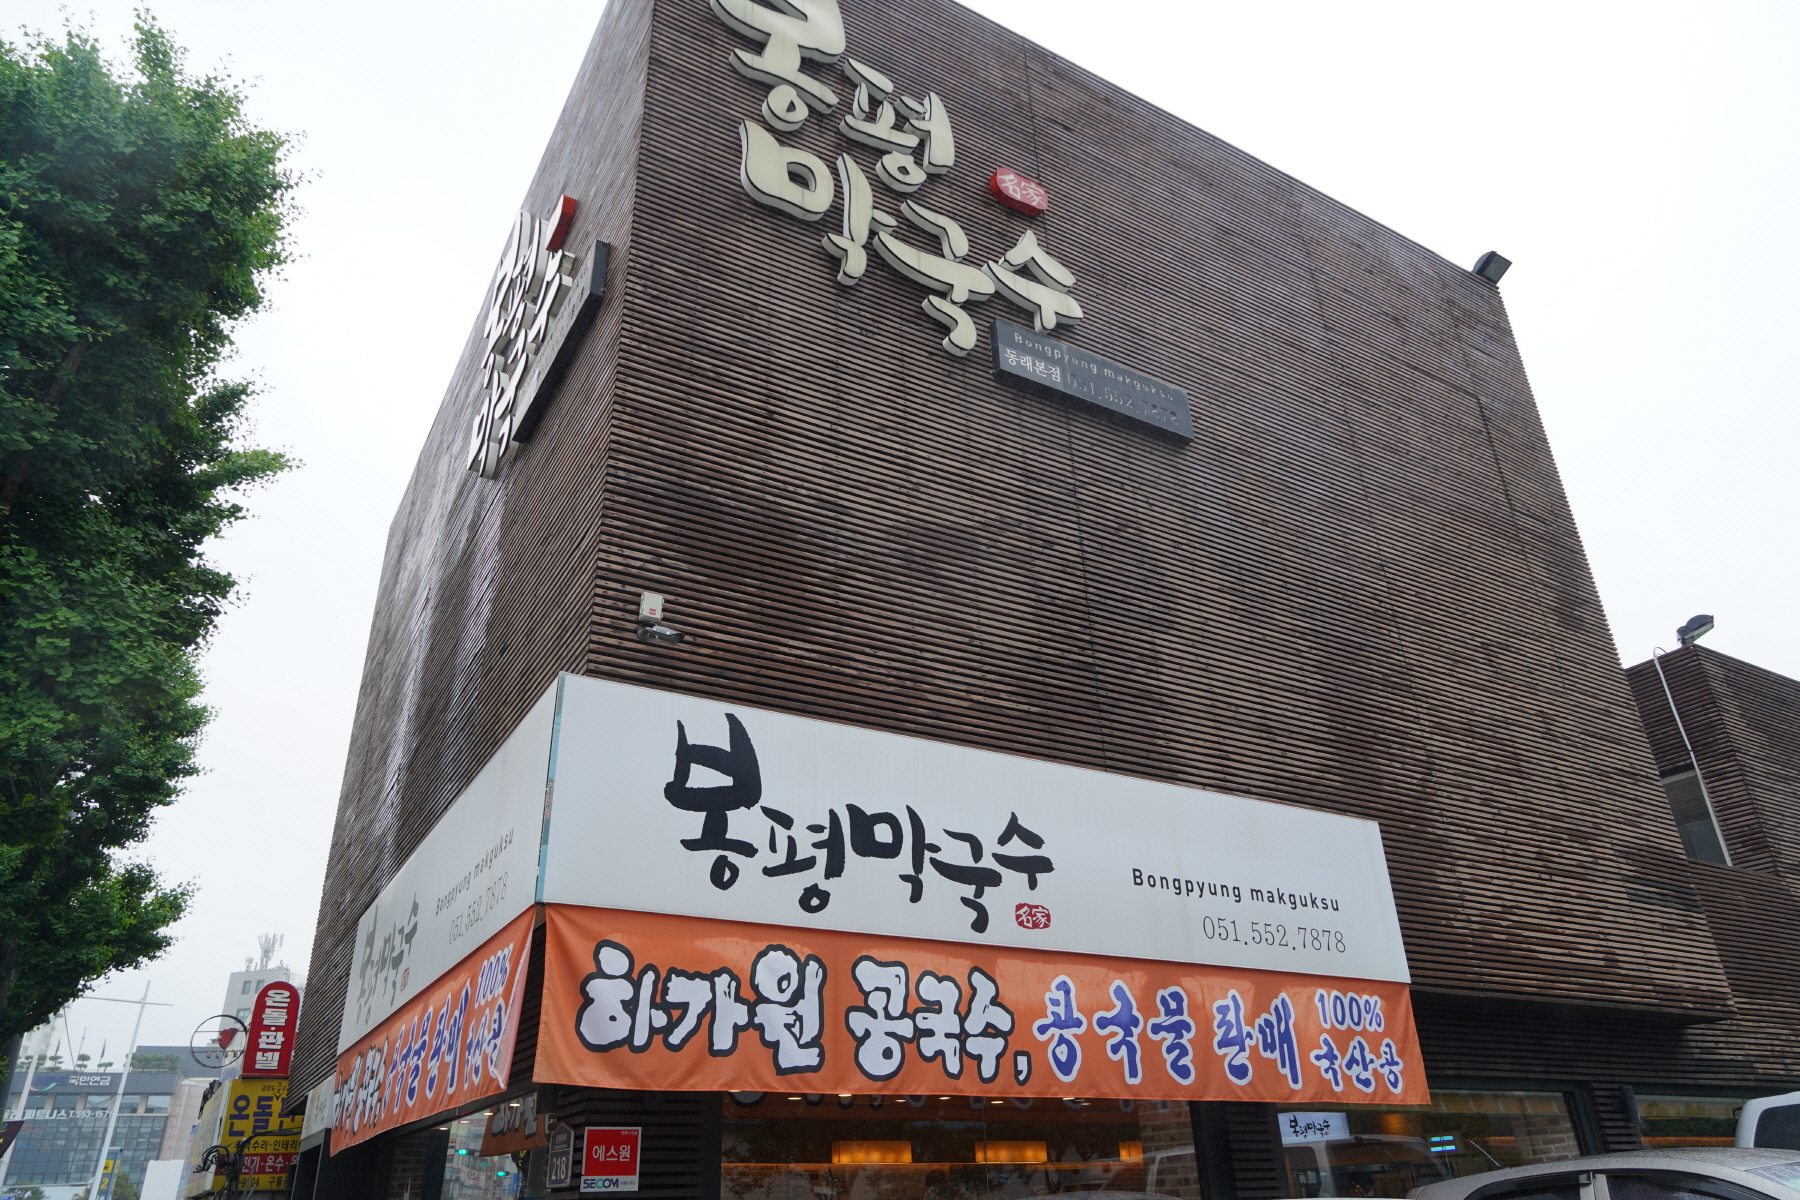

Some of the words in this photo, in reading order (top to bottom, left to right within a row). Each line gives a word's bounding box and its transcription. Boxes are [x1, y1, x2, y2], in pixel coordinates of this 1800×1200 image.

[998, 172, 1045, 206] 名家
[738, 119, 1083, 357] 막국수
[1004, 348, 1061, 383] 동래본점
[1014, 331, 1098, 375] Bongpyung
[1103, 367, 1175, 402] makguksu
[1066, 372, 1180, 427] 051.552.7878
[664, 712, 1055, 934] 봉평막국수
[435, 870, 472, 917] Bongpyung
[473, 828, 514, 880] makguksu
[1132, 867, 1242, 904] Bongpyung
[1250, 885, 1341, 912] makguksu
[447, 871, 509, 945] 051.552.7878
[1016, 904, 1051, 929] 名家
[1202, 915, 1347, 955] 051.552.7878
[474, 942, 514, 1010] 100%
[255, 989, 291, 1070] 온돌·판넬
[578, 940, 827, 1077] 하가원
[1033, 974, 1197, 1086] 콩국물
[1212, 988, 1303, 1090] 판매
[1313, 987, 1386, 1034] 100%
[36, 1075, 67, 1086] NPS
[68, 1075, 111, 1086] 국민연금
[1309, 1032, 1405, 1094] 국산콩
[24, 1109, 68, 1120] 피트니스
[69, 1109, 113, 1119] T.553-1571
[551, 1156, 567, 1180] 218
[592, 1144, 631, 1162] 에스원
[100, 1178, 109, 1189] 2
[583, 1178, 619, 1189] SECOM
